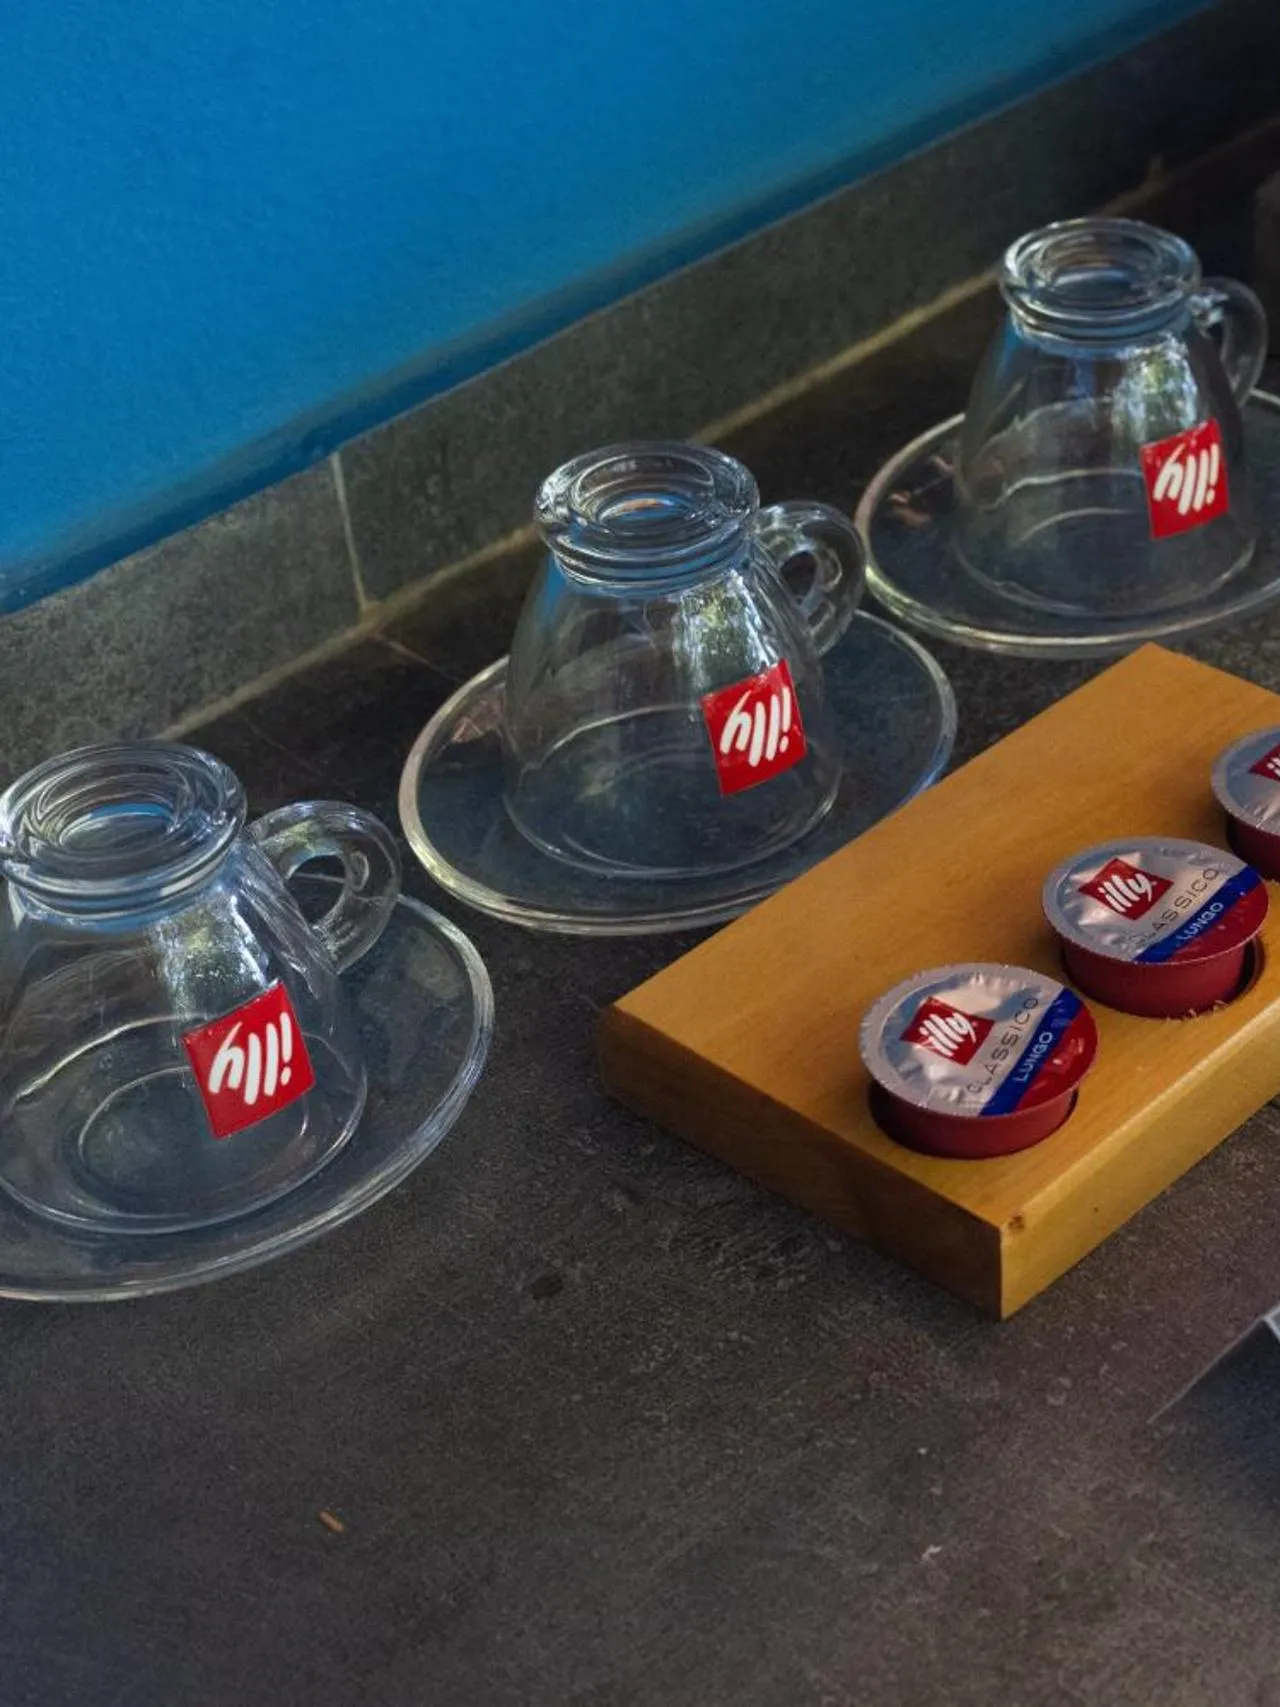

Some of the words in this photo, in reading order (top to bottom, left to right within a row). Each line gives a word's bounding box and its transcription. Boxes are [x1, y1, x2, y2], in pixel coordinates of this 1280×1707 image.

[1152, 442, 1220, 516] illy
[719, 685, 792, 768] illy
[1097, 872, 1153, 913] illy
[1129, 866, 1221, 948] CLASSICO
[1176, 901, 1225, 942] LUNGO
[207, 1010, 293, 1106] illy
[918, 1011, 978, 1058] illy
[966, 997, 1040, 1096] CLASSICO
[1014, 1030, 1054, 1083] LUNGO
